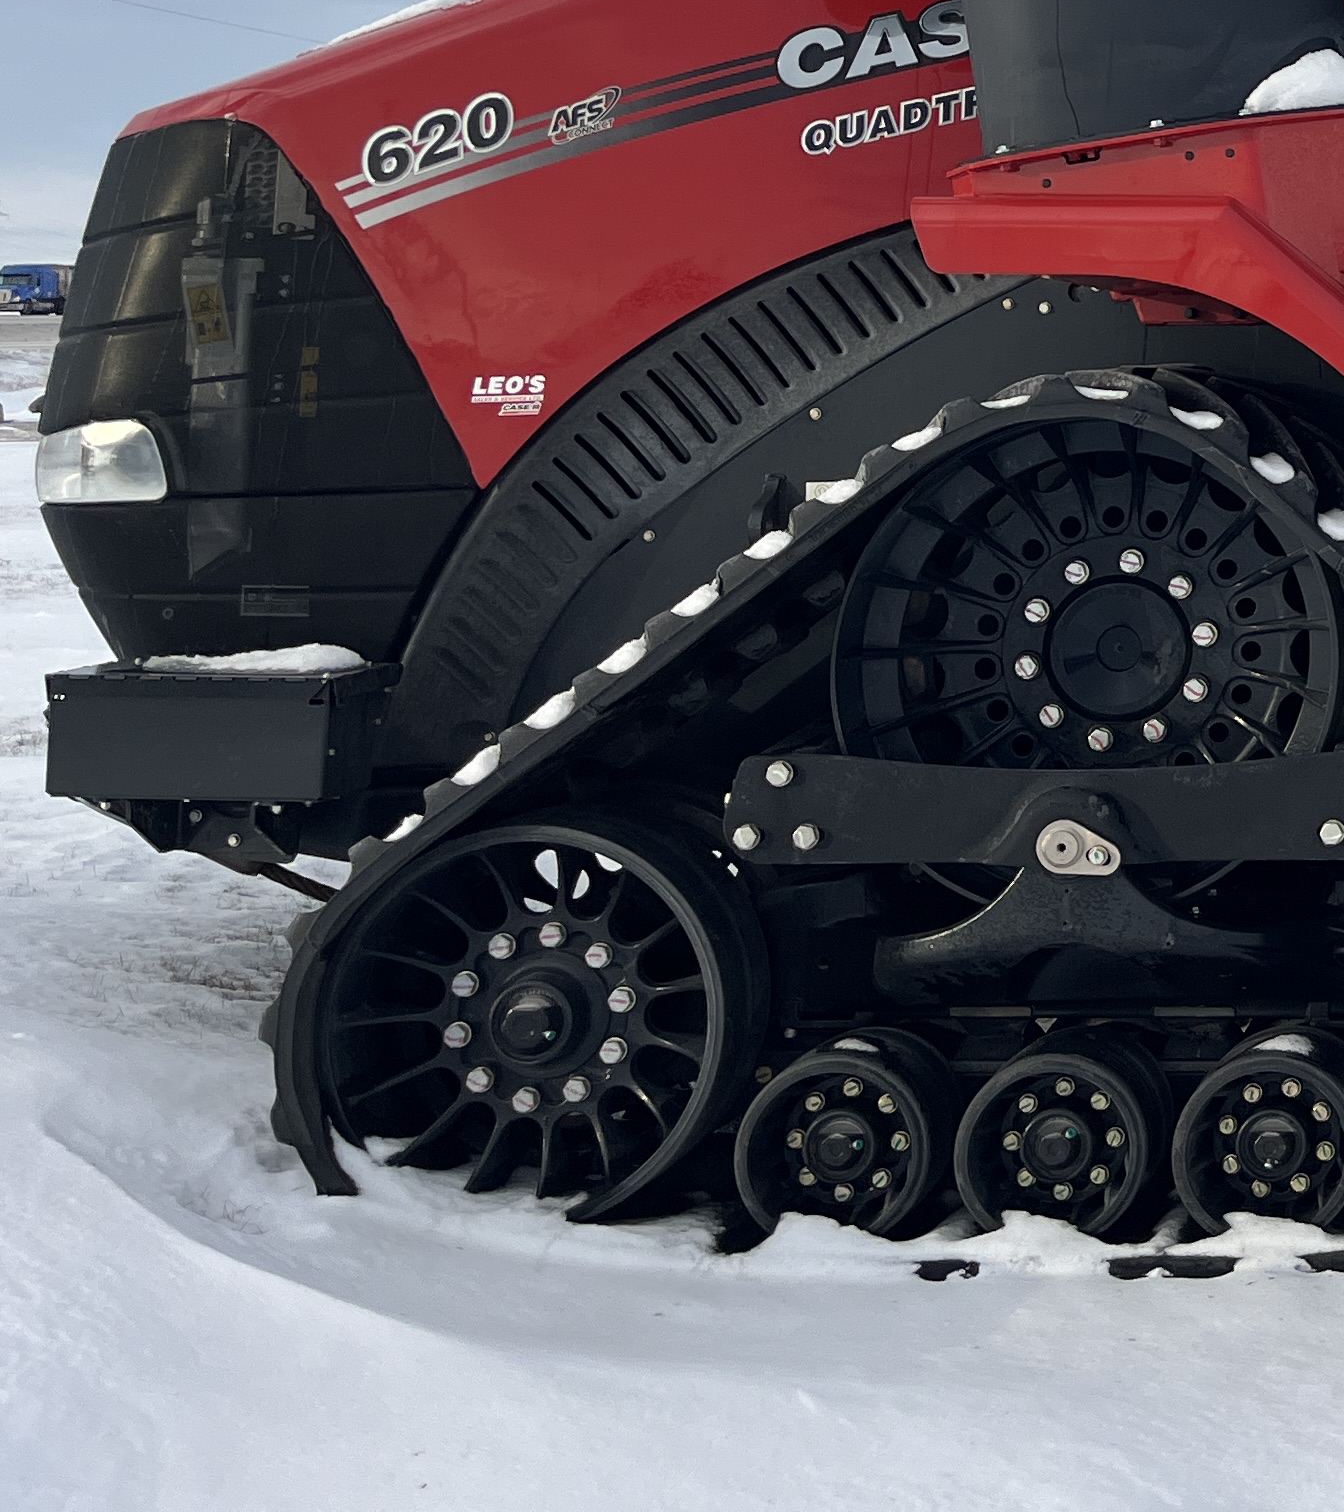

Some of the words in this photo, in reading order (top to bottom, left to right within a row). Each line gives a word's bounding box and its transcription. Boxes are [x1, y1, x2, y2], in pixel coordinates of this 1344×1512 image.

[549, 95, 606, 135] AFS
[568, 118, 615, 140] CONNECT
[362, 92, 514, 186] 620
[472, 375, 546, 395] LEO'S
